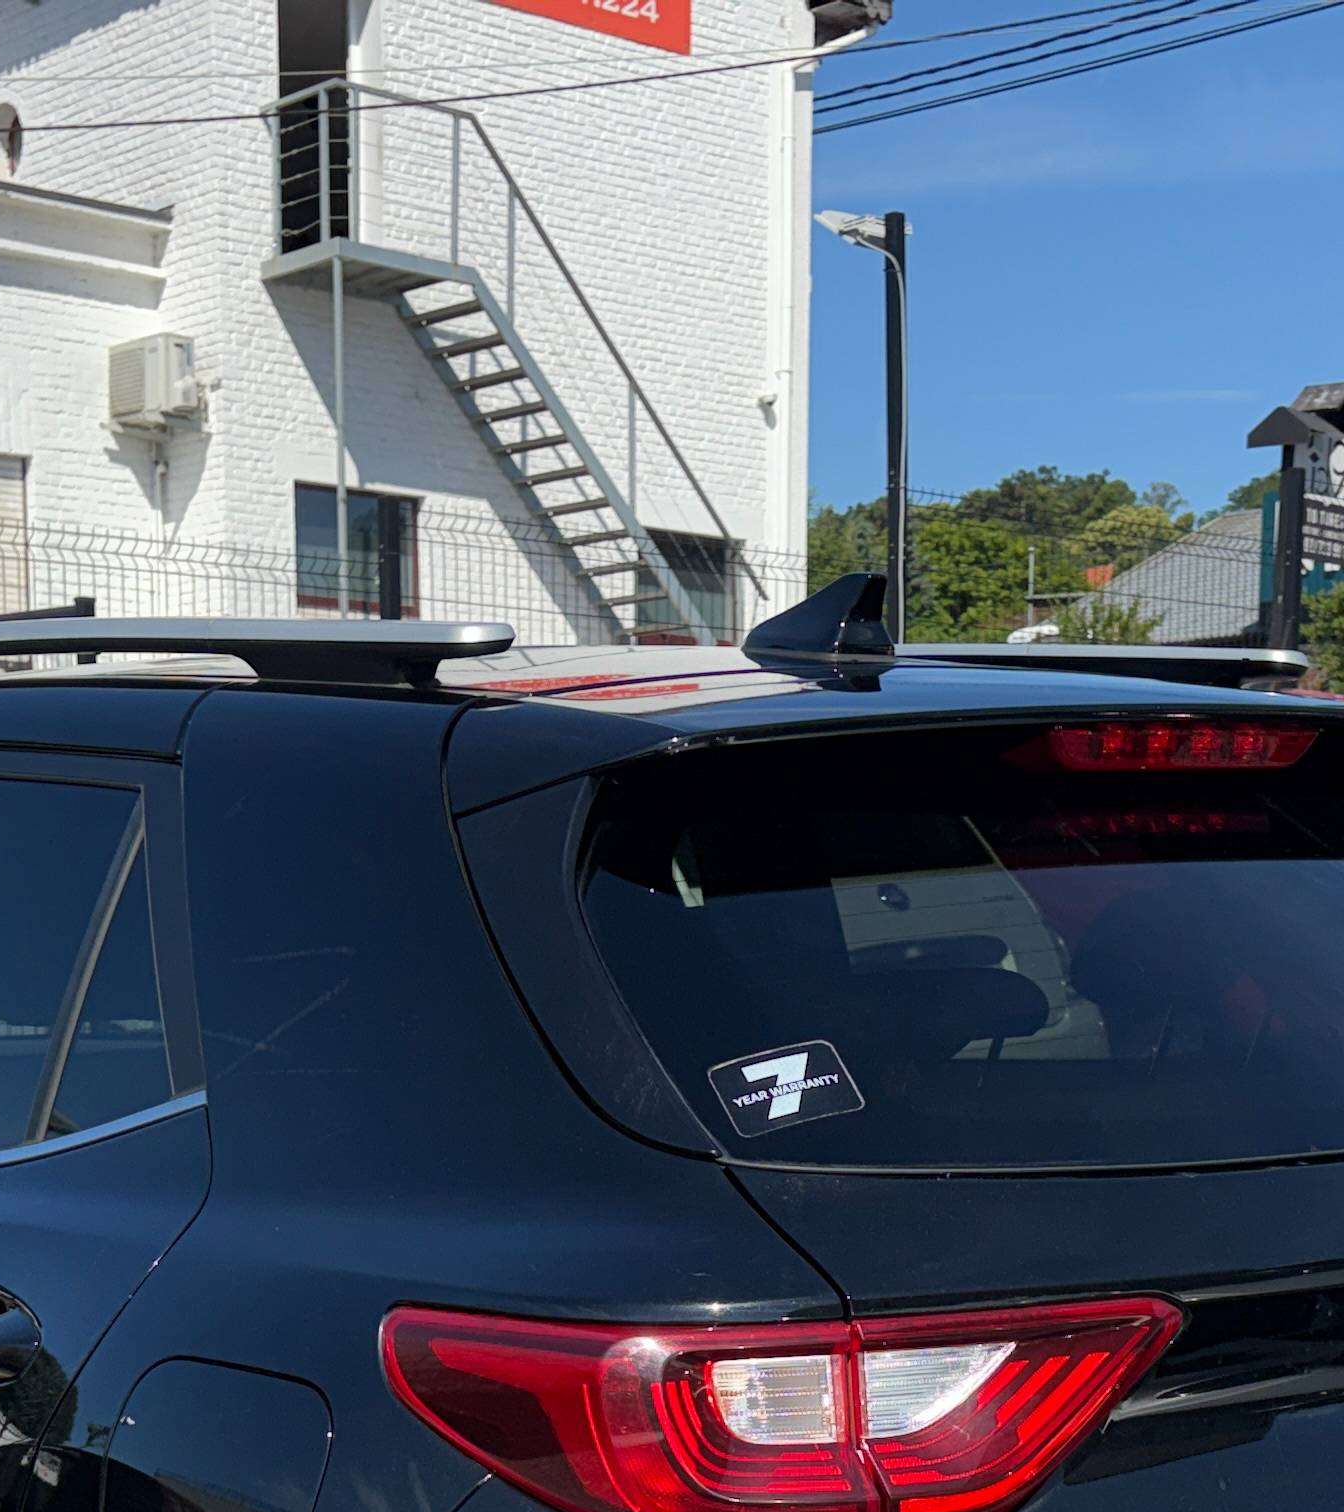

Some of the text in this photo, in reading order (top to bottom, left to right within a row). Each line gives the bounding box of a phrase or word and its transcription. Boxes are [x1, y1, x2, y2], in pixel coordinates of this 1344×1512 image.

[732, 1073, 839, 1108] YEAR WARRANTY
[741, 1052, 809, 1120] 7
